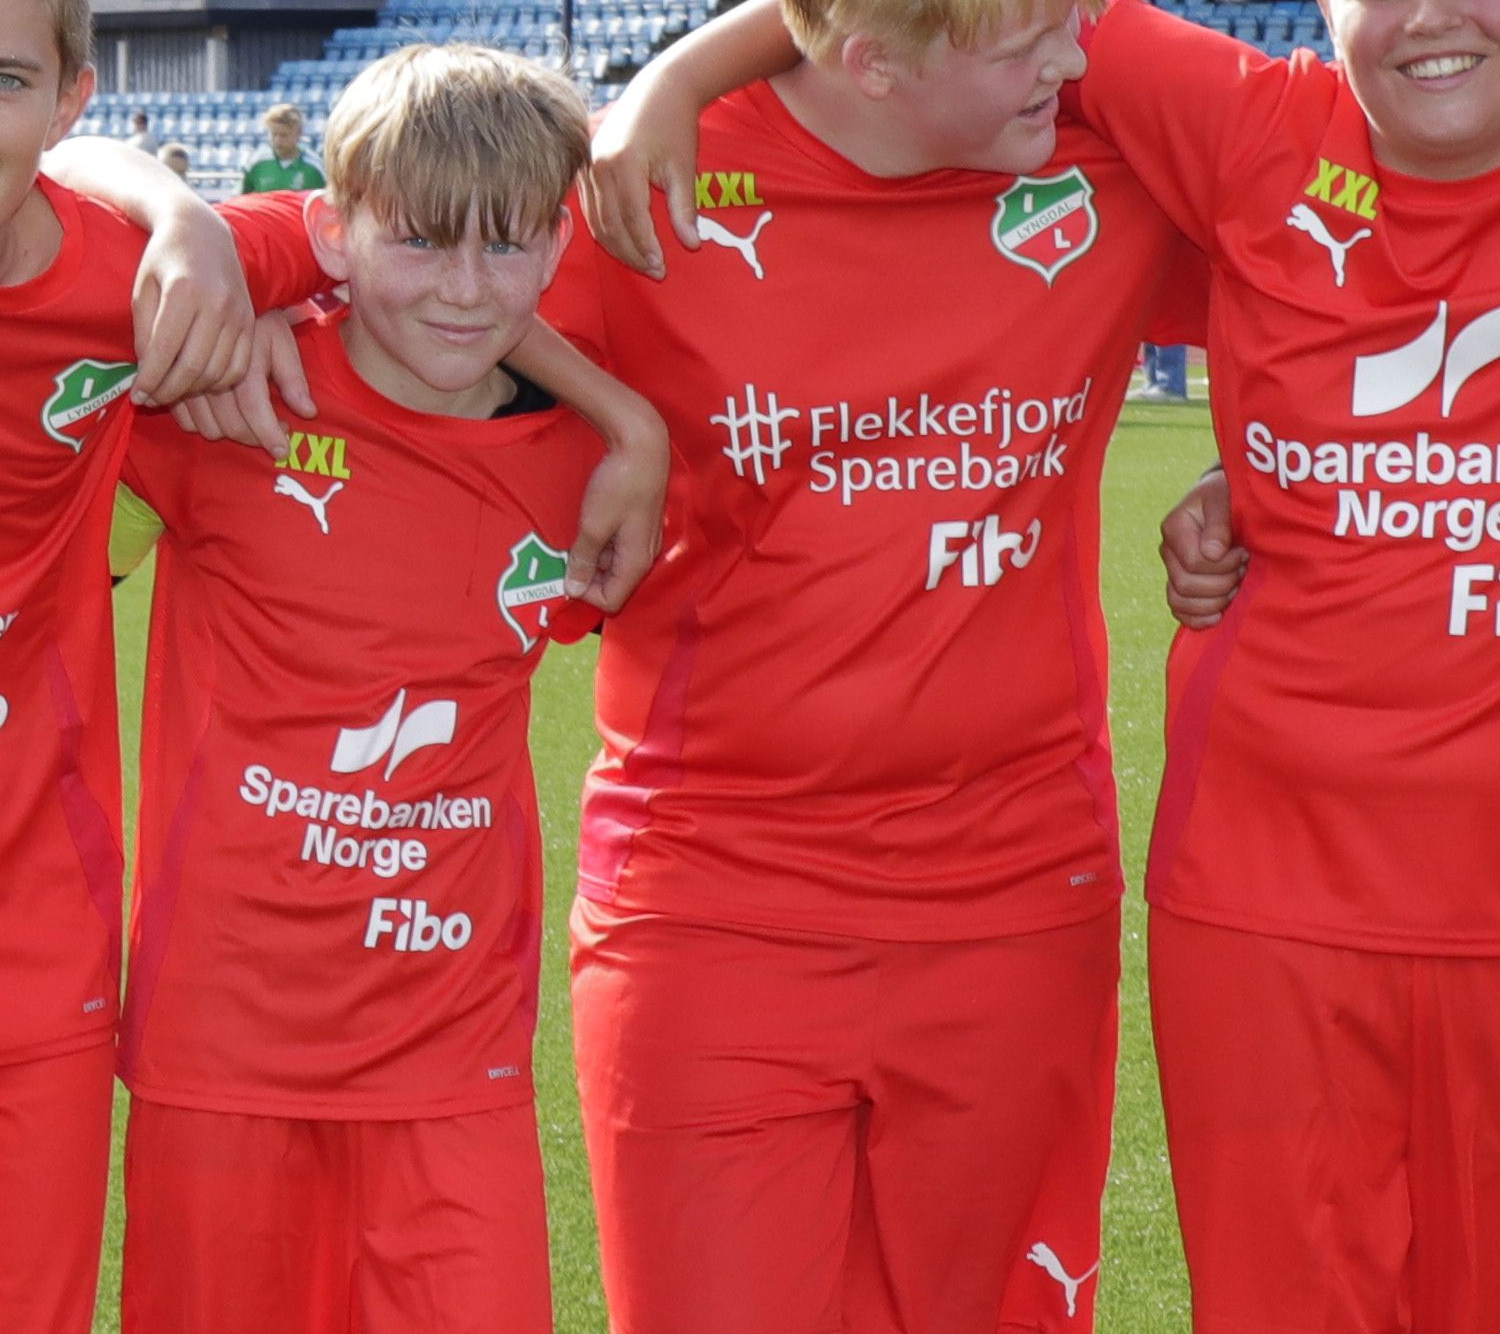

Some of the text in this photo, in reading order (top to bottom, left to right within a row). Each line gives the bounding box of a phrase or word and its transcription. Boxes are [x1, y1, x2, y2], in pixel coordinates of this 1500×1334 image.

[1305, 158, 1381, 220] XXL
[1016, 201, 1073, 240] LYNGDAL
[67, 385, 123, 421] LYNGDAL
[809, 377, 1093, 449] Flekkefjord
[275, 431, 351, 480] XXL
[808, 435, 1066, 506] Sparebank
[238, 763, 492, 831] Sparebanken
[300, 822, 428, 878] Norge
[363, 897, 473, 953] Fibo
